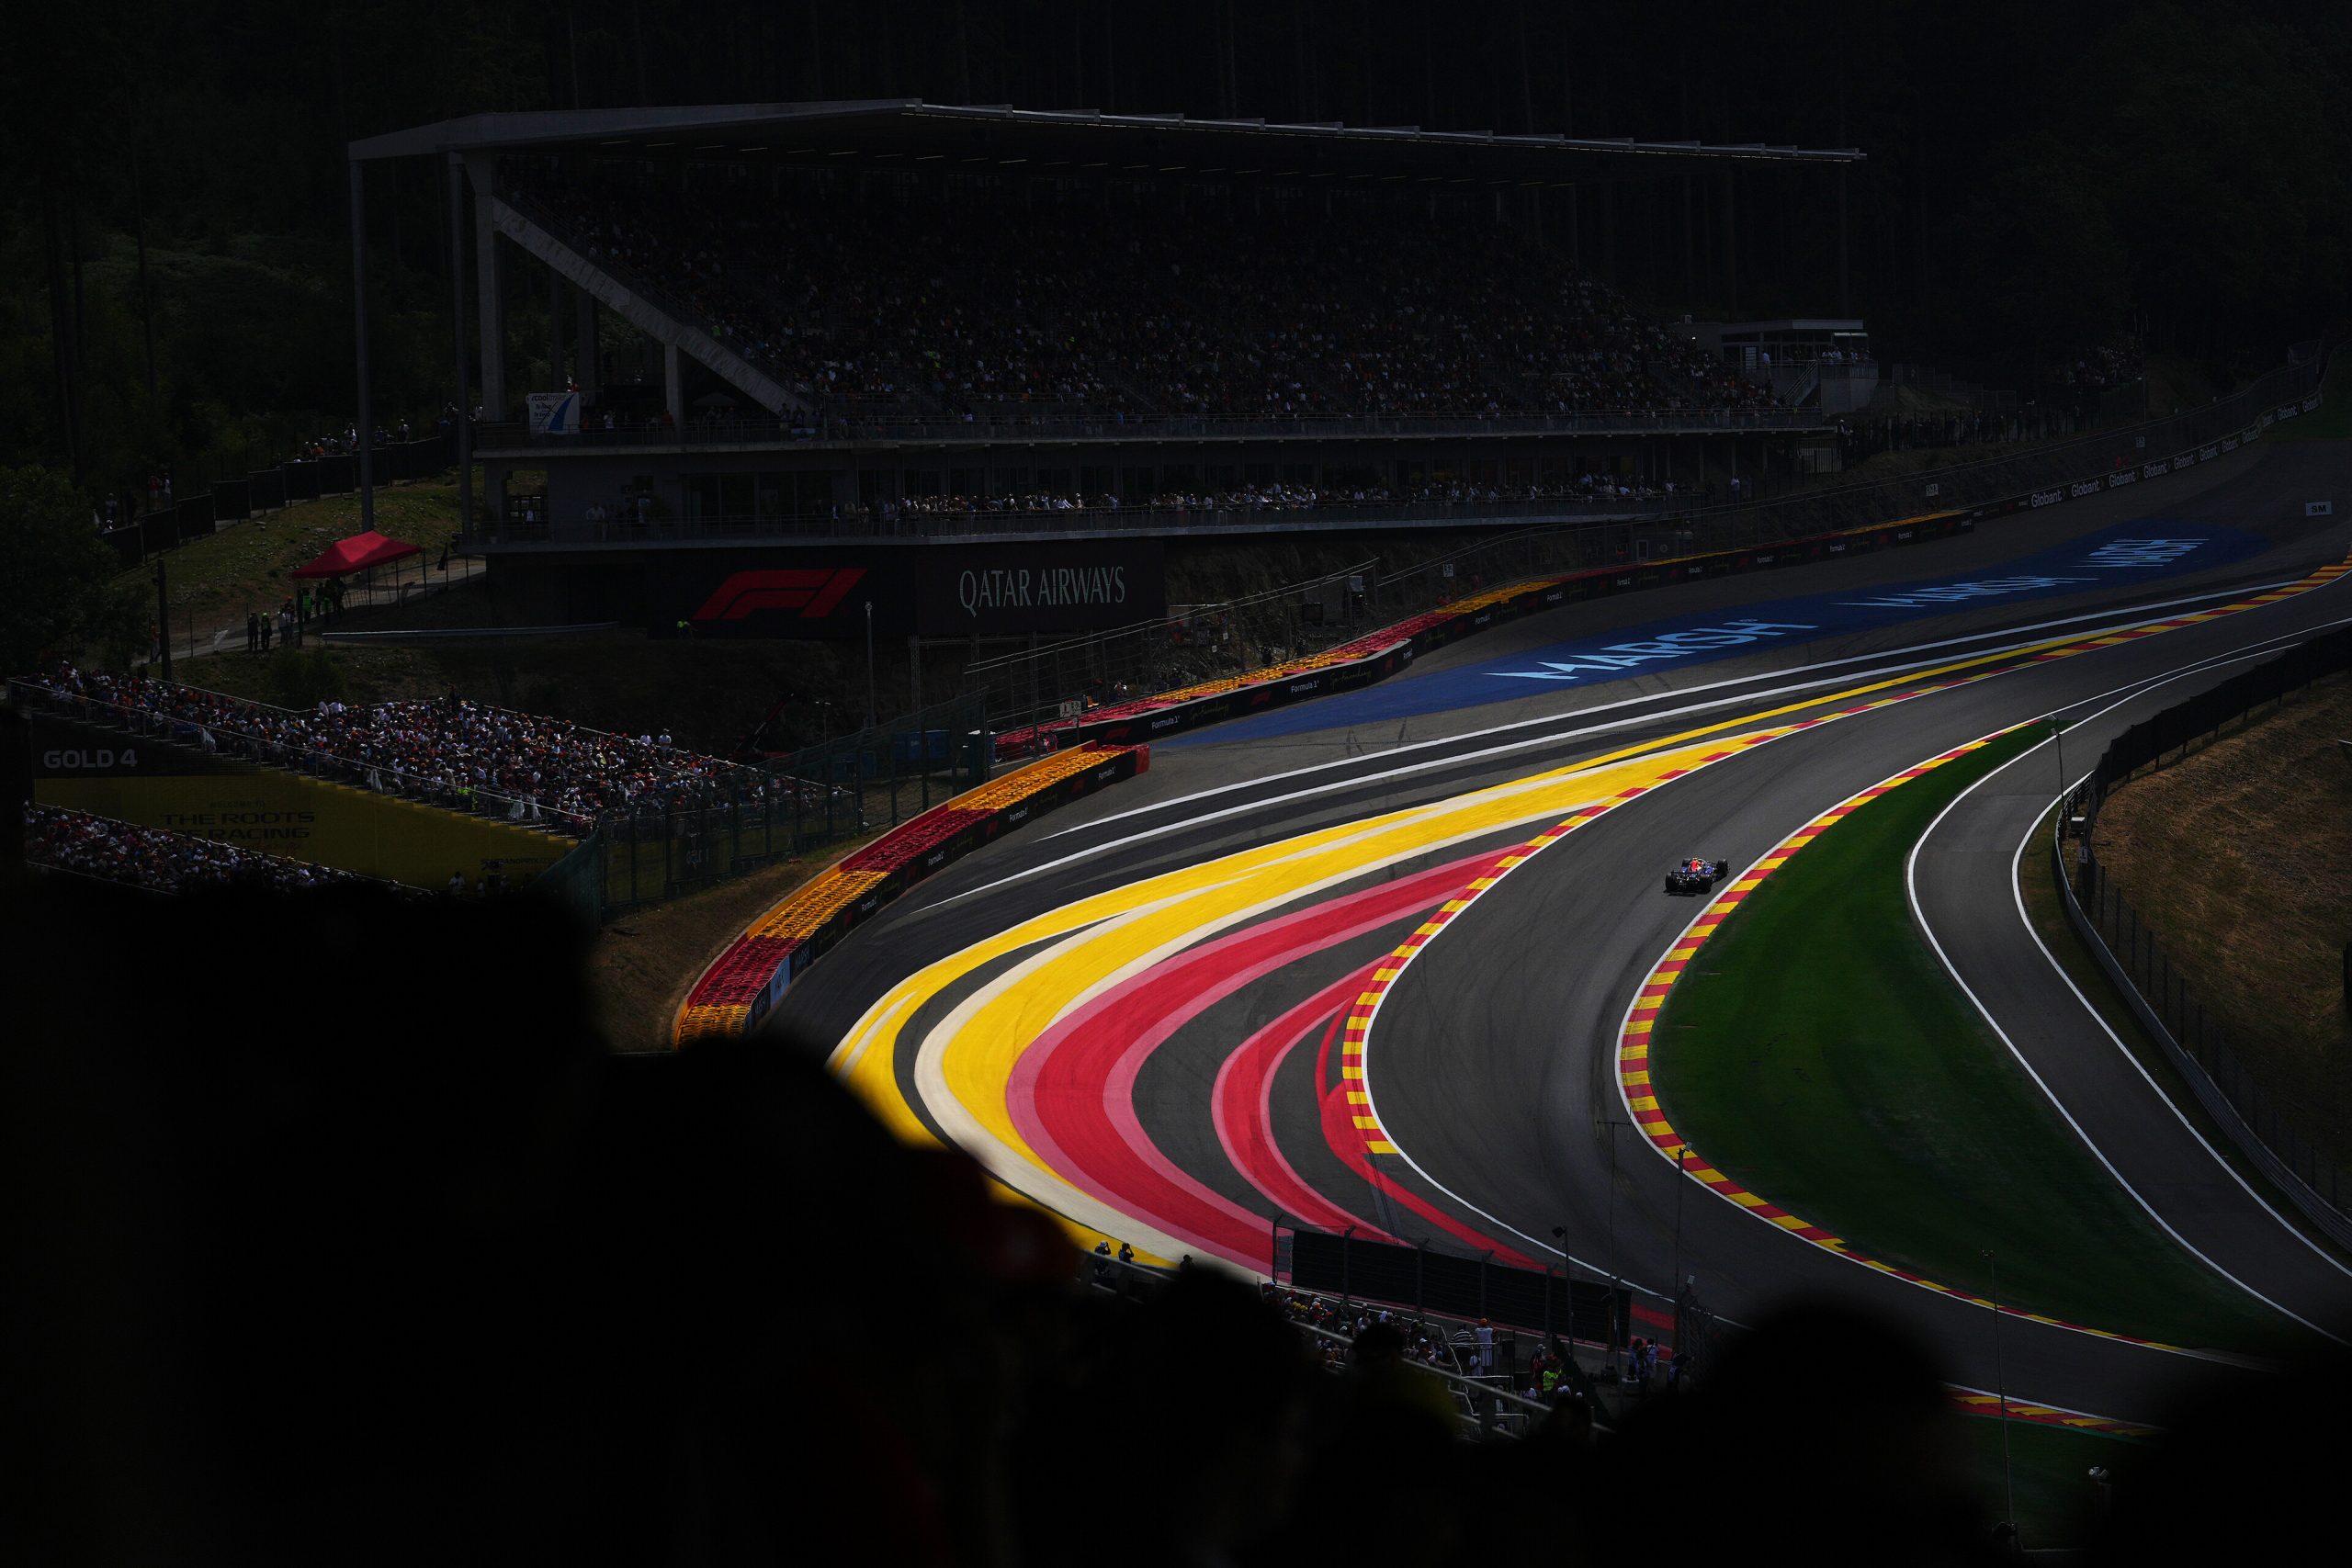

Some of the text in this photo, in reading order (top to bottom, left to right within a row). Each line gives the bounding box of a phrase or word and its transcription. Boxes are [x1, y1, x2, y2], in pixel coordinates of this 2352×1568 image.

[2109, 470, 2136, 488] Globant
[2143, 462, 2168, 478] Globant
[2071, 479, 2100, 497] Globant
[2030, 490, 2063, 508] Globant
[691, 568, 868, 621] F1
[959, 566, 1126, 618] QATAR AIRWAYS
[1482, 620, 1823, 681] MARSH
[1290, 682, 1313, 694] Formula
[1151, 717, 1174, 730] Formula
[44, 749, 138, 769] GOLD 4
[160, 811, 316, 825] THE ROOTS
[209, 828, 310, 840] RACING
